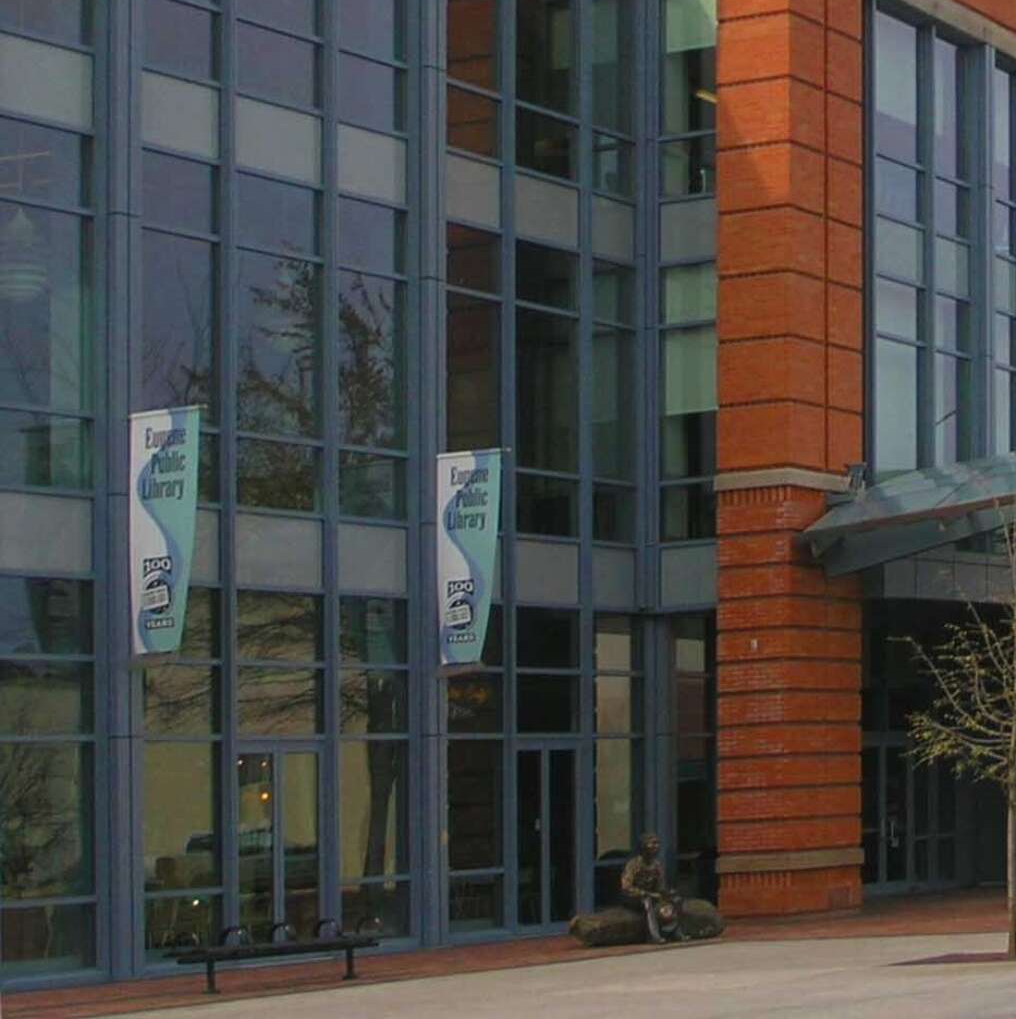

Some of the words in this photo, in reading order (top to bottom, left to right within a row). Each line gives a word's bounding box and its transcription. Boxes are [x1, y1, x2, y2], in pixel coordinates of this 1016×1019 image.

[145, 427, 186, 451] Eugene
[151, 451, 186, 474] Public
[451, 466, 489, 488] Eugene
[142, 477, 184, 500] Library
[455, 489, 488, 508] Public
[447, 511, 486, 531] Library
[144, 558, 172, 573] 100
[448, 581, 474, 594] 100
